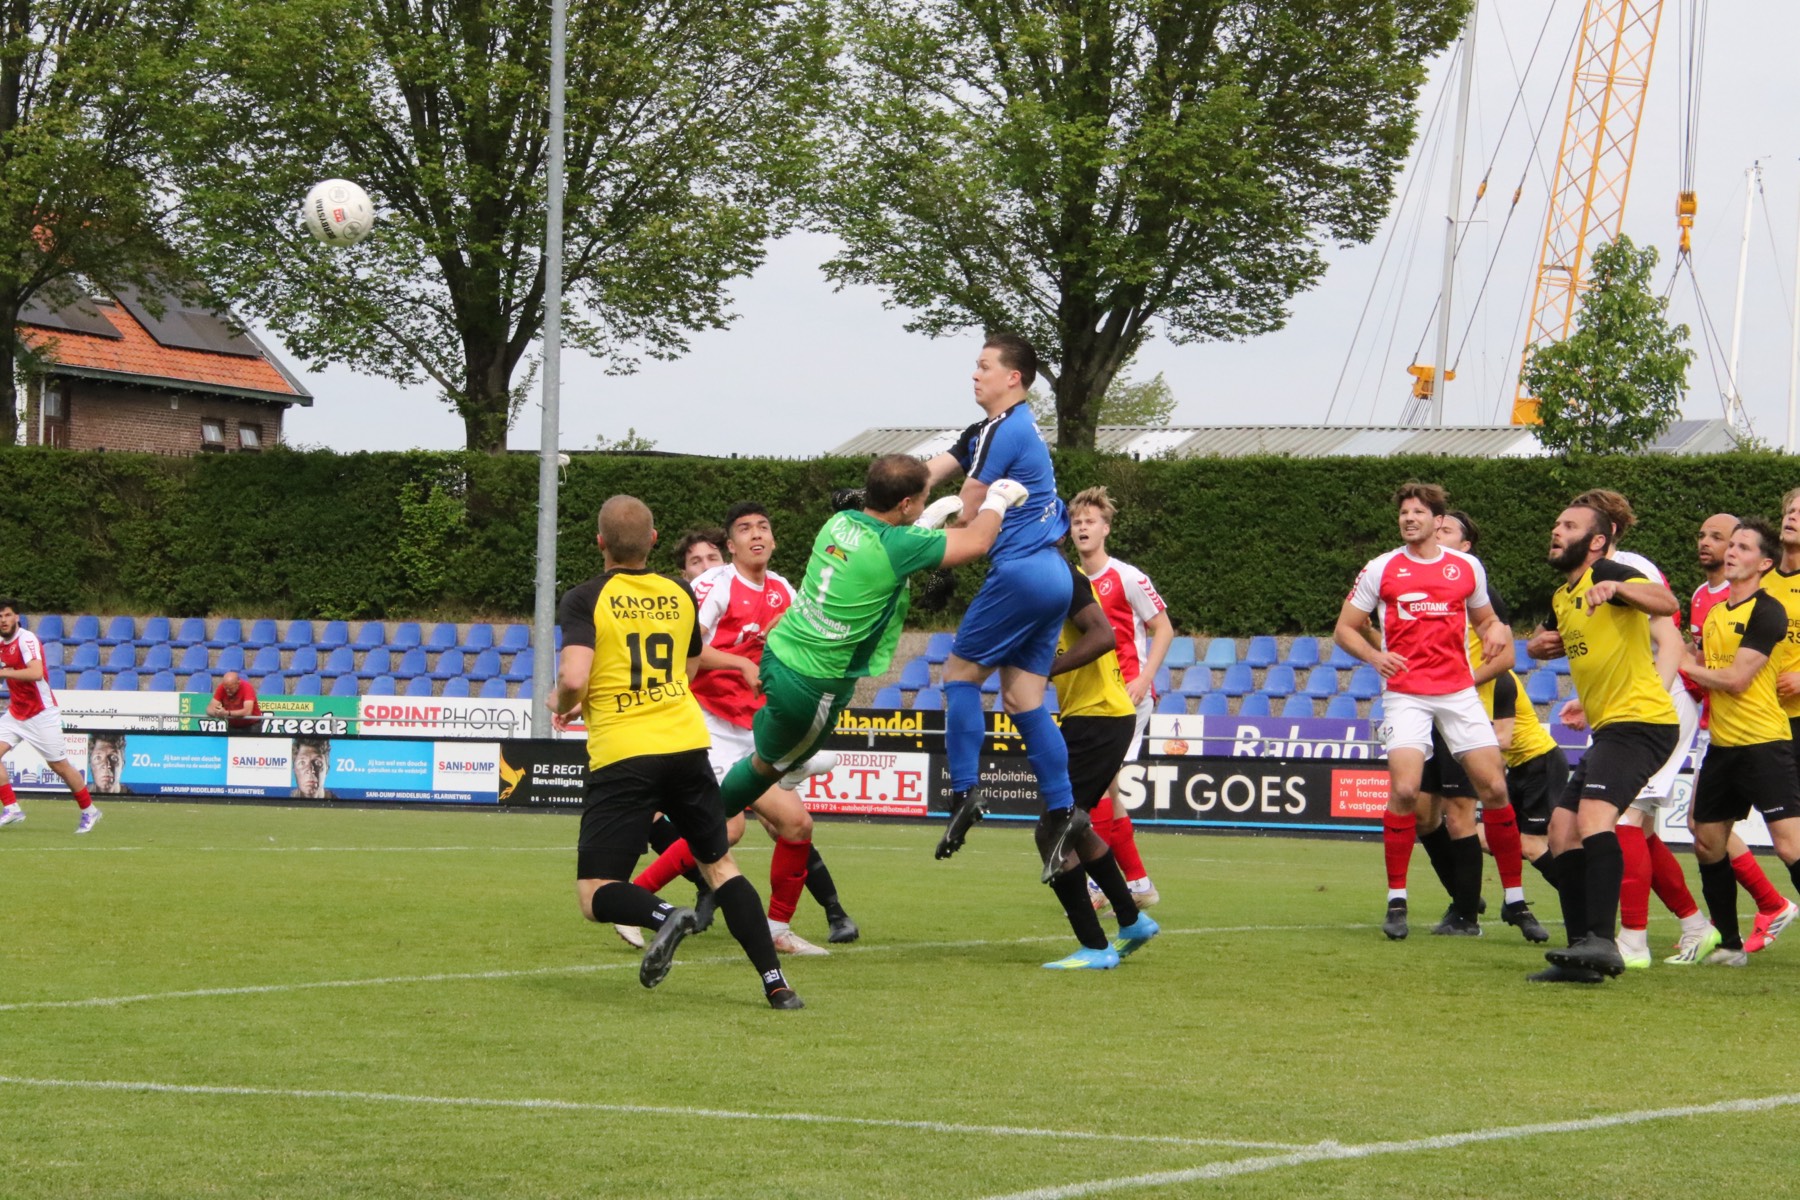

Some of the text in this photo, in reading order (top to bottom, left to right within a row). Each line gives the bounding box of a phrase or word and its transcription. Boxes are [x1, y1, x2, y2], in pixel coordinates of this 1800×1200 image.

[816, 566, 834, 604] 1
[610, 595, 679, 610] KNOPS
[1410, 602, 1448, 612] ECOTANK
[612, 610, 680, 620] VASTGOED
[626, 632, 674, 691] 19
[199, 719, 227, 733] van
[1231, 724, 1387, 759] Rabob
[132, 753, 161, 767] ZO...
[232, 756, 287, 767] SANI-DUMP
[336, 758, 365, 772] ZO...
[438, 761, 495, 771] SANI-DUMP
[533, 764, 585, 775] DE REGT
[980, 768, 1038, 784] exploitaties
[532, 777, 584, 788] Beveiliging
[805, 769, 922, 802] R.T.E
[1118, 764, 1306, 814] ST GOES
[1340, 776, 1389, 788] uw partner
[1339, 788, 1389, 798] in horeca
[1339, 801, 1388, 812] & vastgoed
